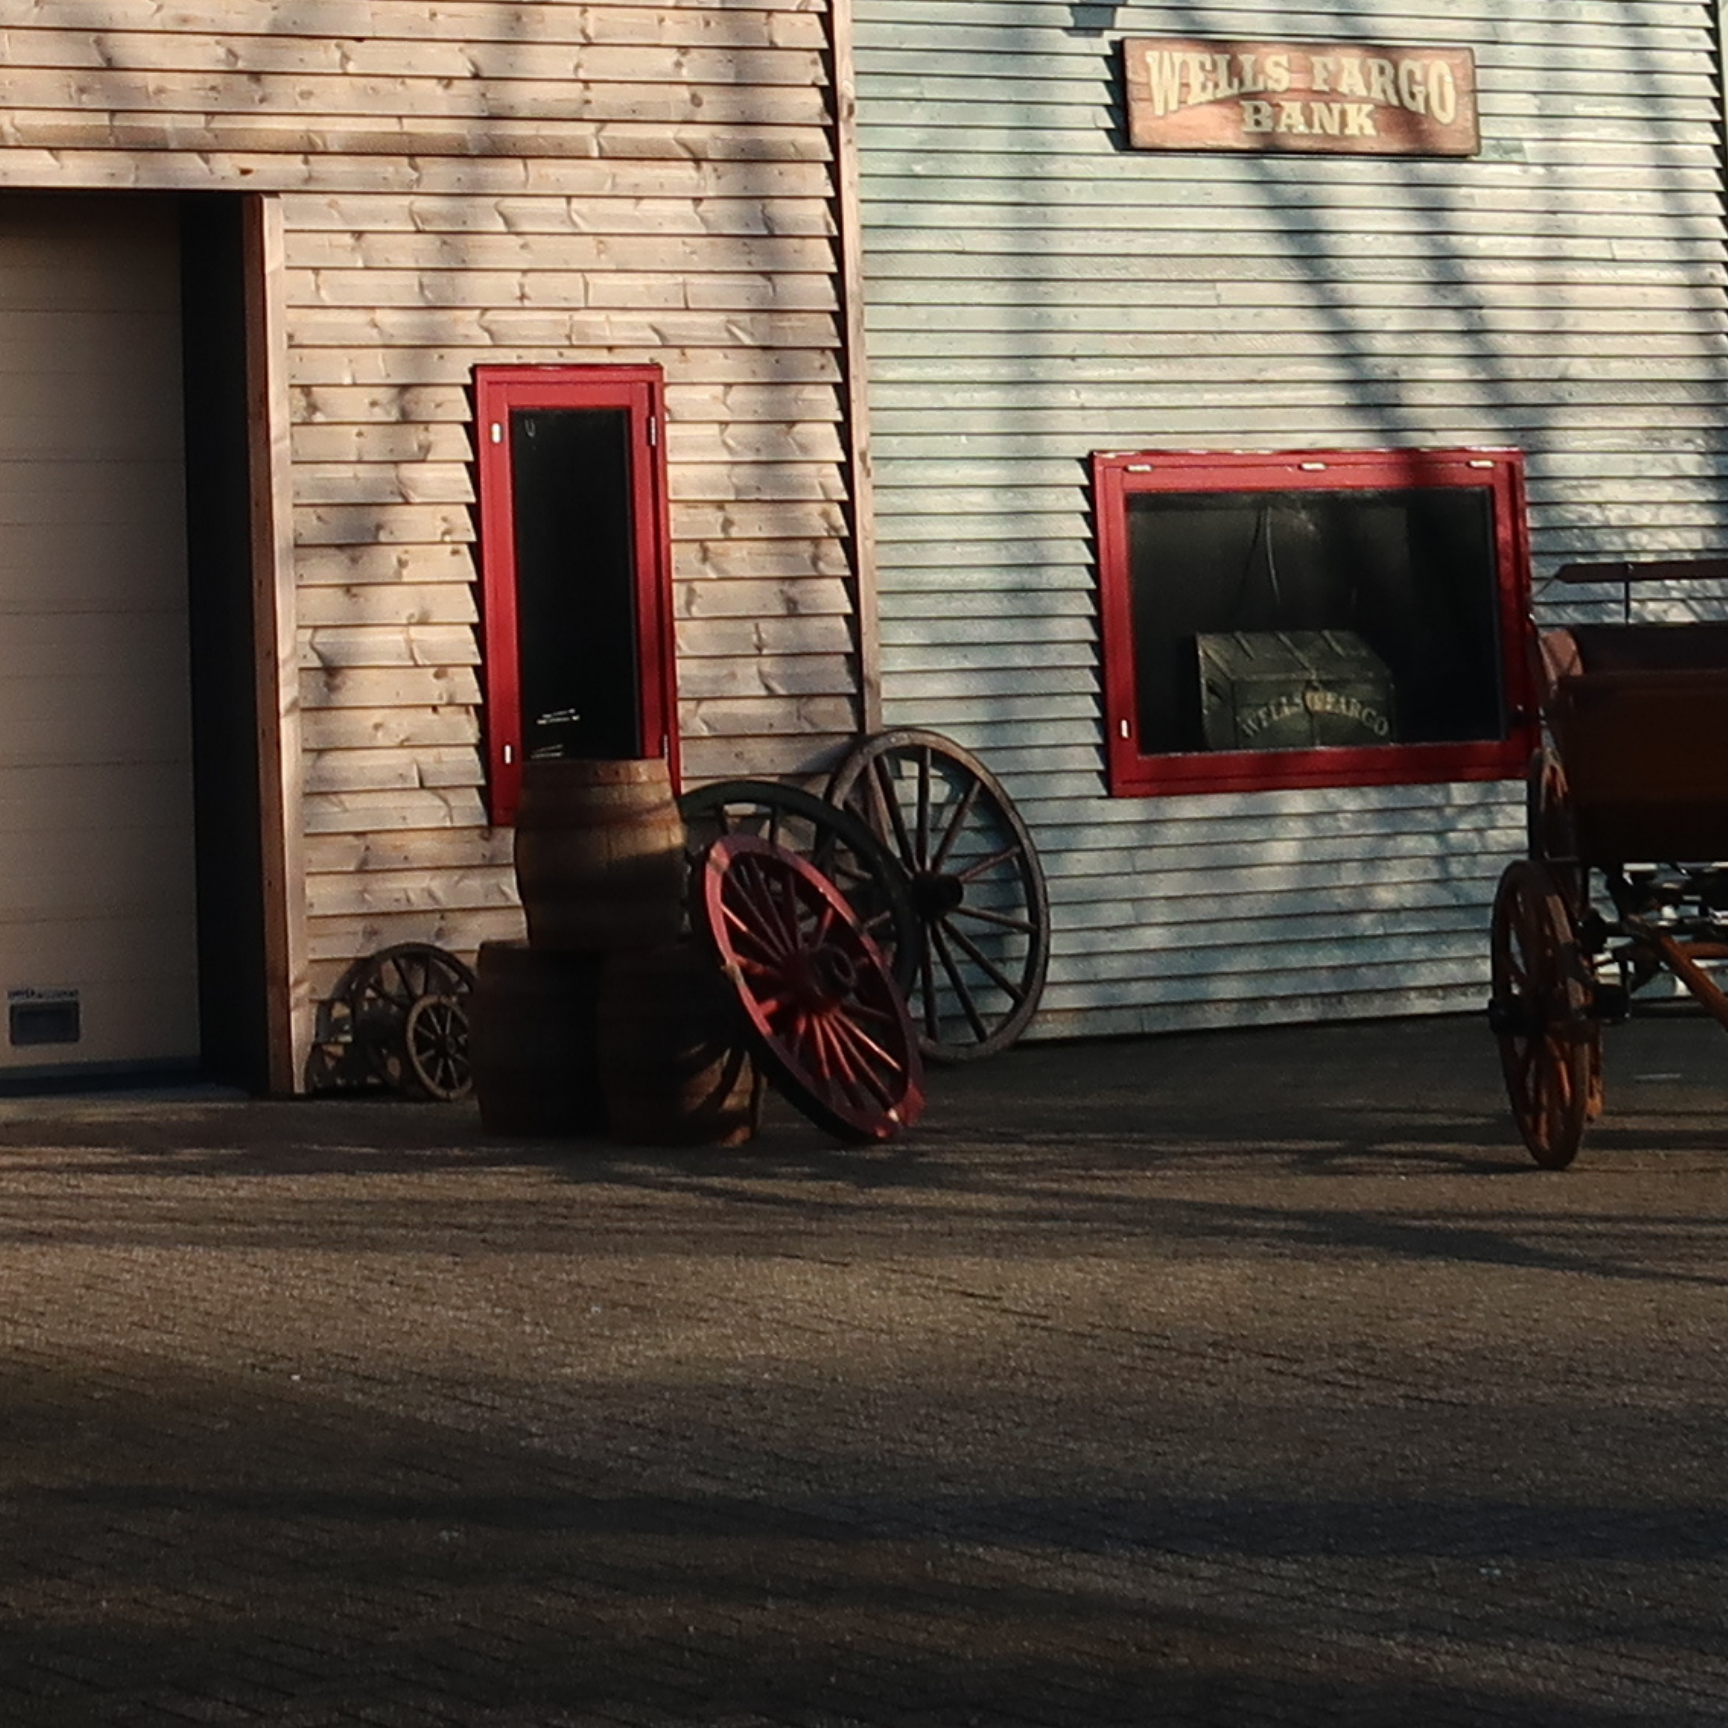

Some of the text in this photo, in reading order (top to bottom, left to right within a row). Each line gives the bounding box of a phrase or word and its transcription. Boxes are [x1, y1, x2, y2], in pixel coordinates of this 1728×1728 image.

[1145, 49, 1458, 126] WELLS FARGO
[1239, 99, 1379, 138] BANK
